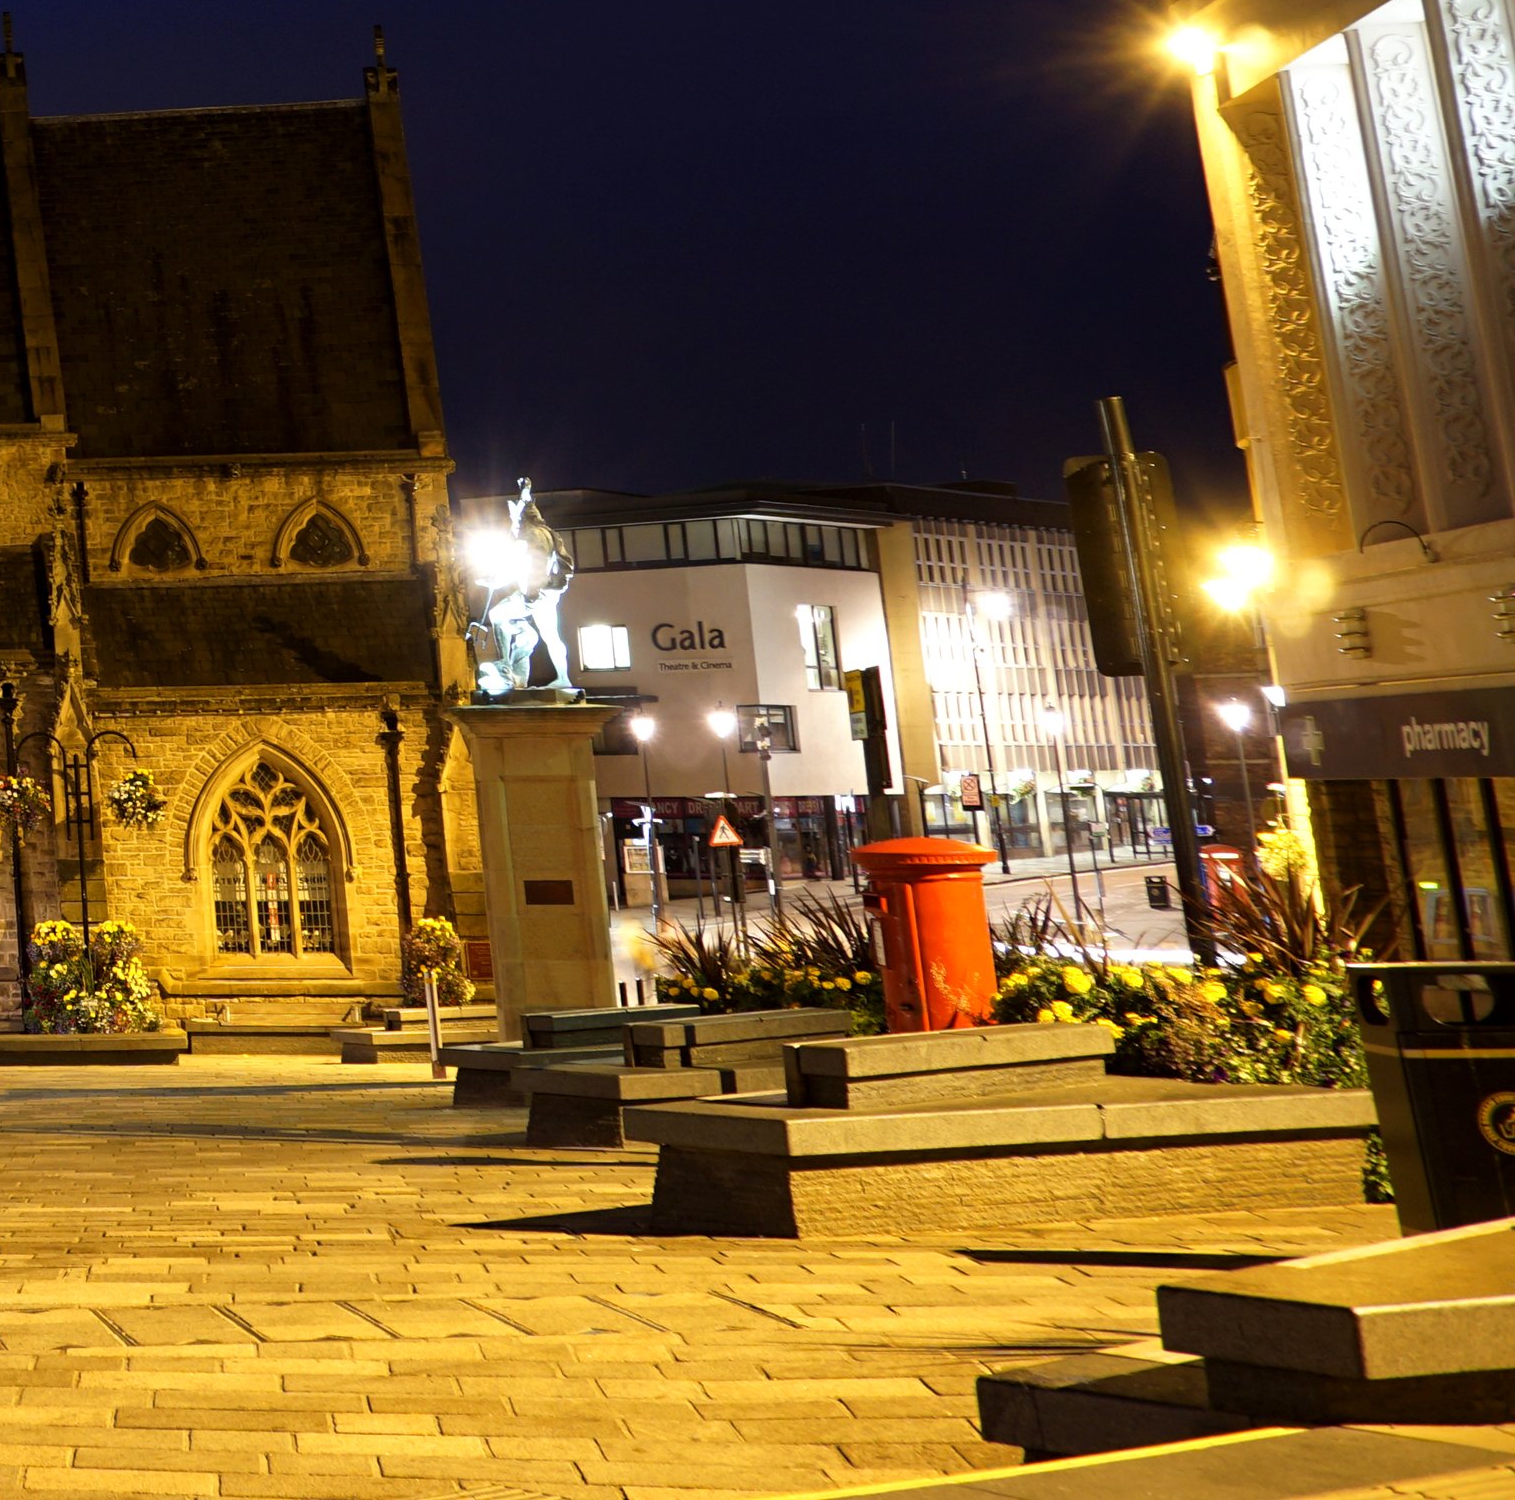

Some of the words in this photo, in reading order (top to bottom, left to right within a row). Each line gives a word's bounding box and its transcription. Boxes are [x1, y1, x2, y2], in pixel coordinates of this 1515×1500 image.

[651, 621, 726, 652] Gala
[659, 662, 690, 671] Theatre
[691, 661, 699, 670] &
[700, 661, 732, 670] Cinema
[1400, 716, 1490, 758] pharmacy
